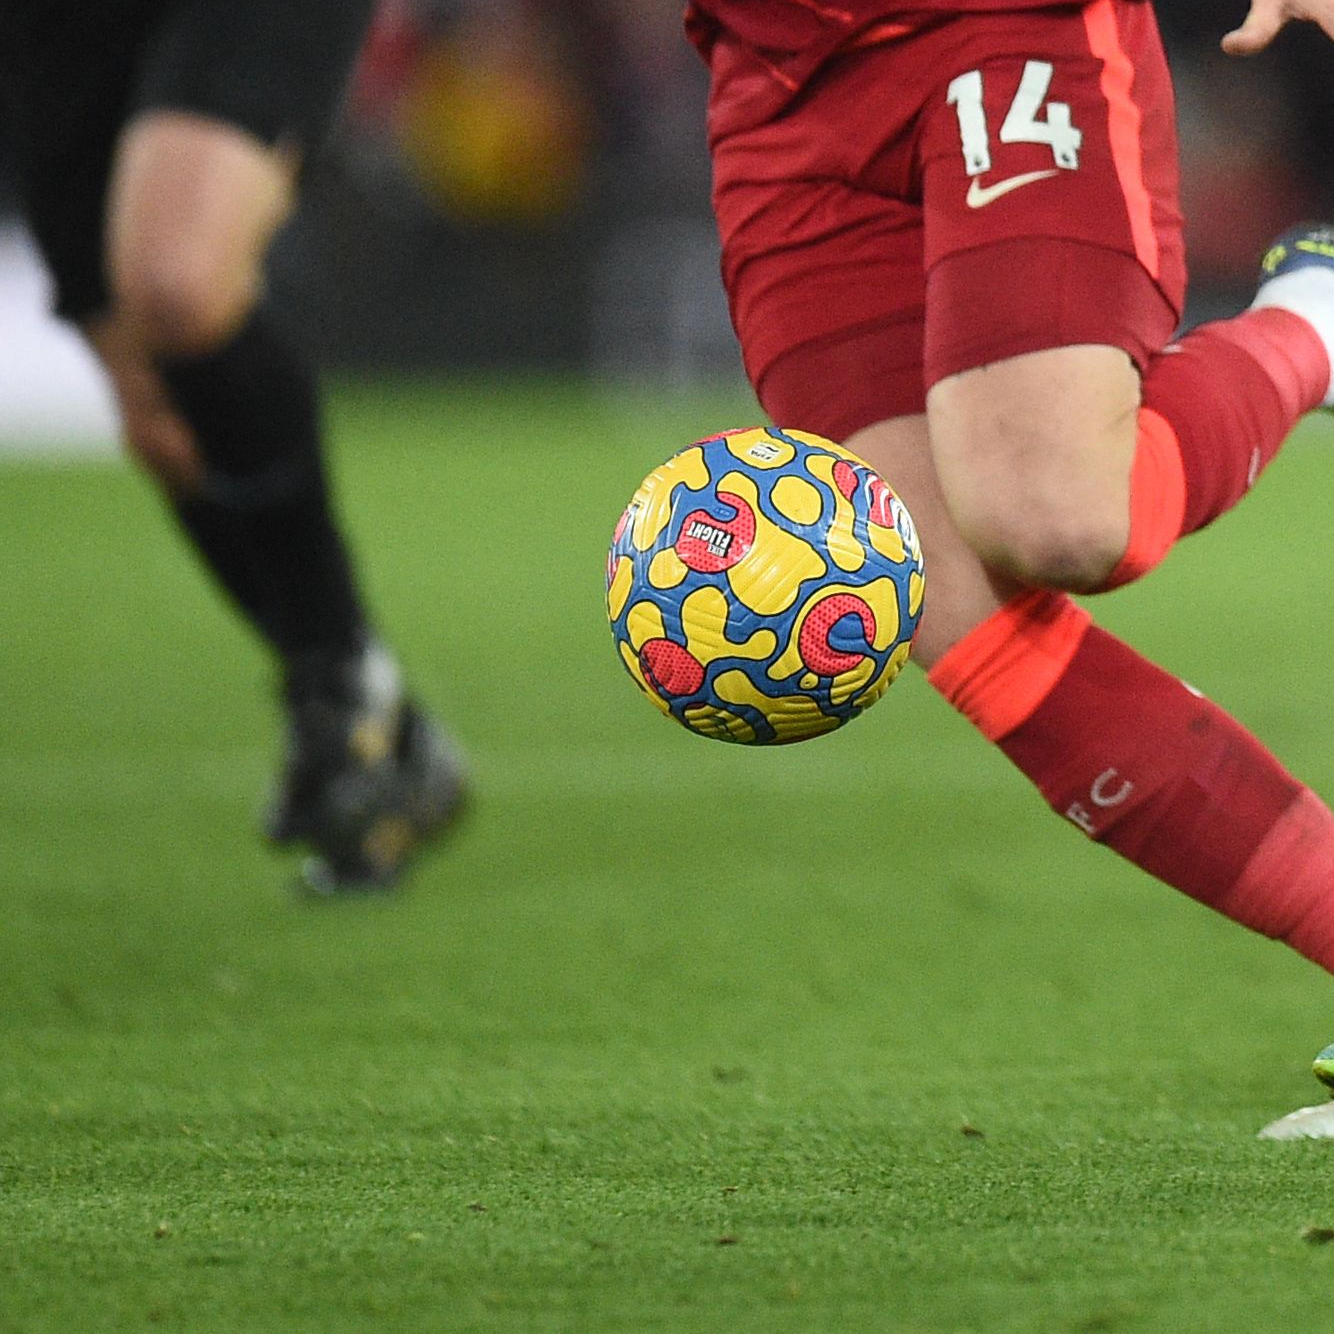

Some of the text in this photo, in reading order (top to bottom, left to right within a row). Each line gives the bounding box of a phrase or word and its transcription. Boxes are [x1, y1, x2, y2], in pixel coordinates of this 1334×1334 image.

[946, 59, 1083, 177] 14
[685, 521, 732, 550] FLIGHT
[1065, 767, 1133, 835] FC
